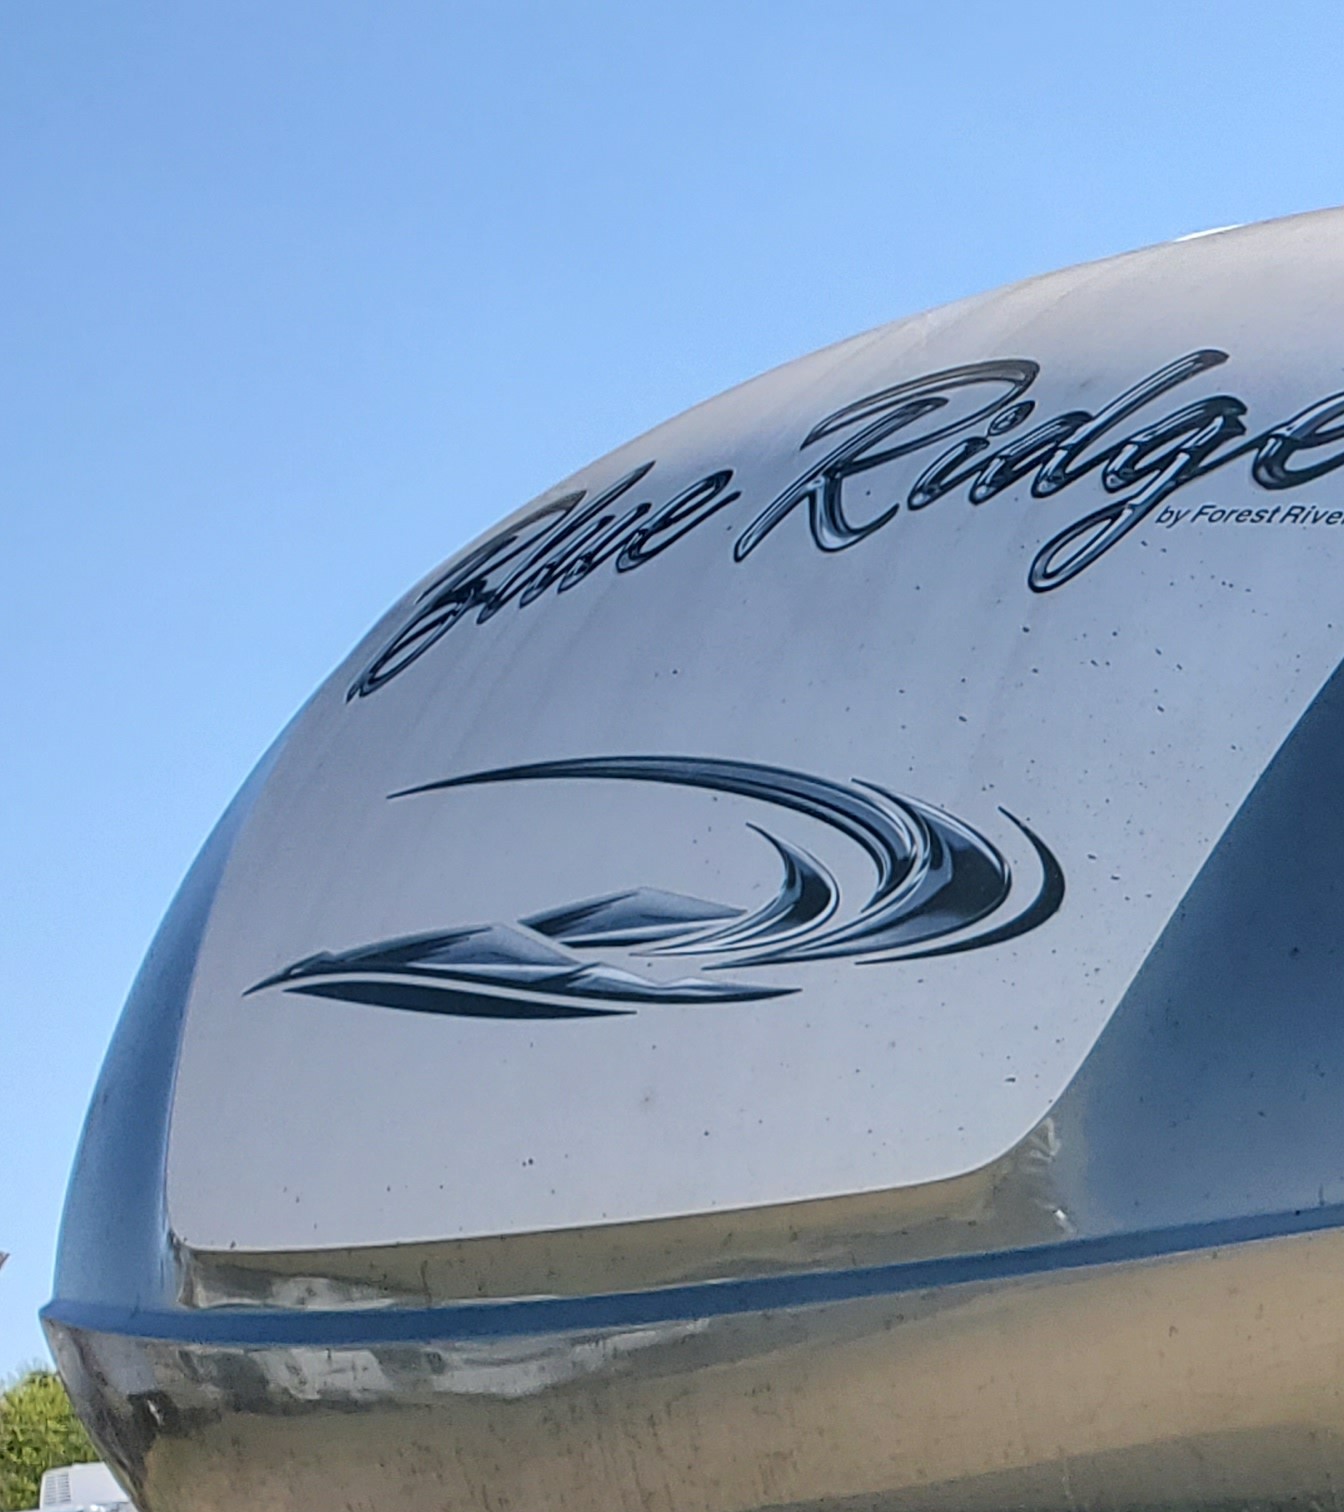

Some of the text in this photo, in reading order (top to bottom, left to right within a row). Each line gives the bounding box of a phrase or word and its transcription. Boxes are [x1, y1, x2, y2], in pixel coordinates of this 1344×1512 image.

[346, 461, 740, 703] Blue
[1155, 504, 1191, 529] by
[1190, 503, 1281, 525] Forest
